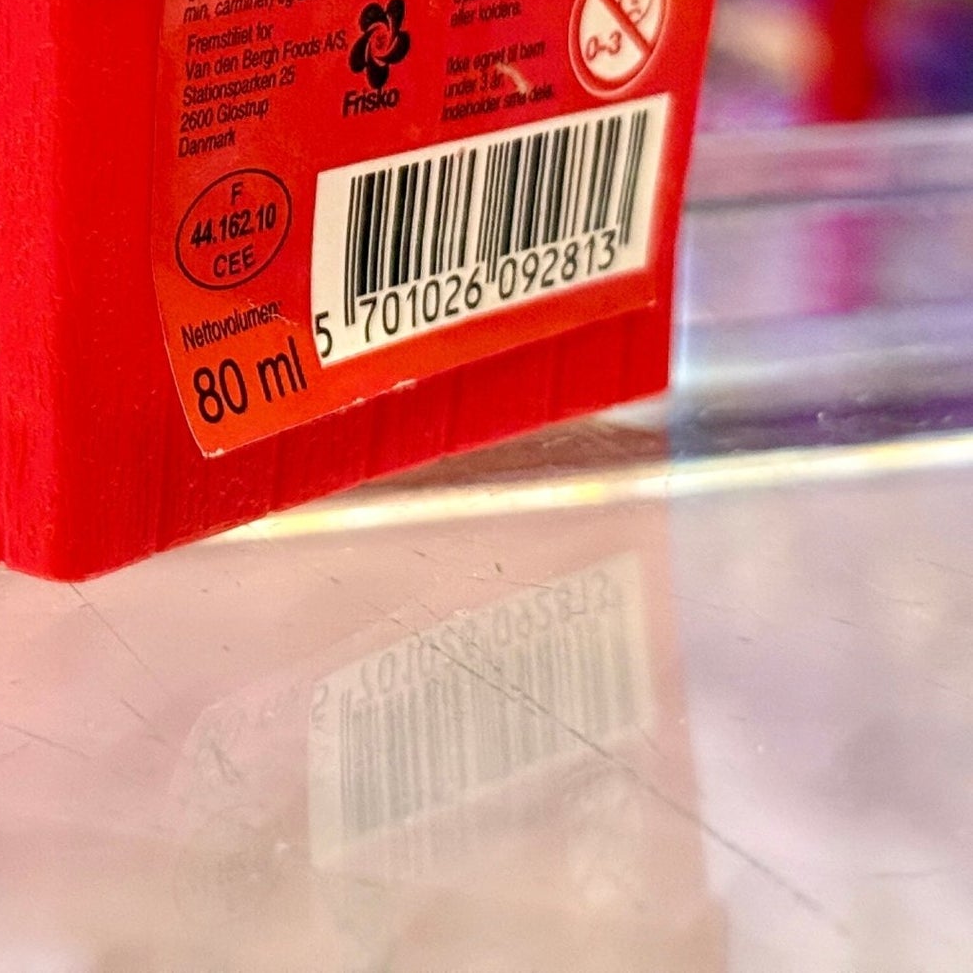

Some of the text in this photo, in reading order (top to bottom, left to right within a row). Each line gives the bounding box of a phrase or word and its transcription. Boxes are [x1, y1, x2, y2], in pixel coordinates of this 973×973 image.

[187, 25, 253, 56] Fremstillet
[586, 30, 623, 62] 0-3
[185, 60, 211, 82] Van
[213, 53, 238, 75] den
[242, 45, 278, 71] Bergh
[282, 37, 321, 61] Foods
[181, 64, 296, 109] Stationsparken 25
[342, 87, 401, 118] Frisko
[179, 96, 270, 134] 2600 Glostrup
[178, 127, 237, 158] Danmark
[230, 180, 244, 206] F
[213, 242, 257, 279] CEE
[313, 229, 618, 359] 5 701026 092813
[193, 334, 308, 424] 80 ml
